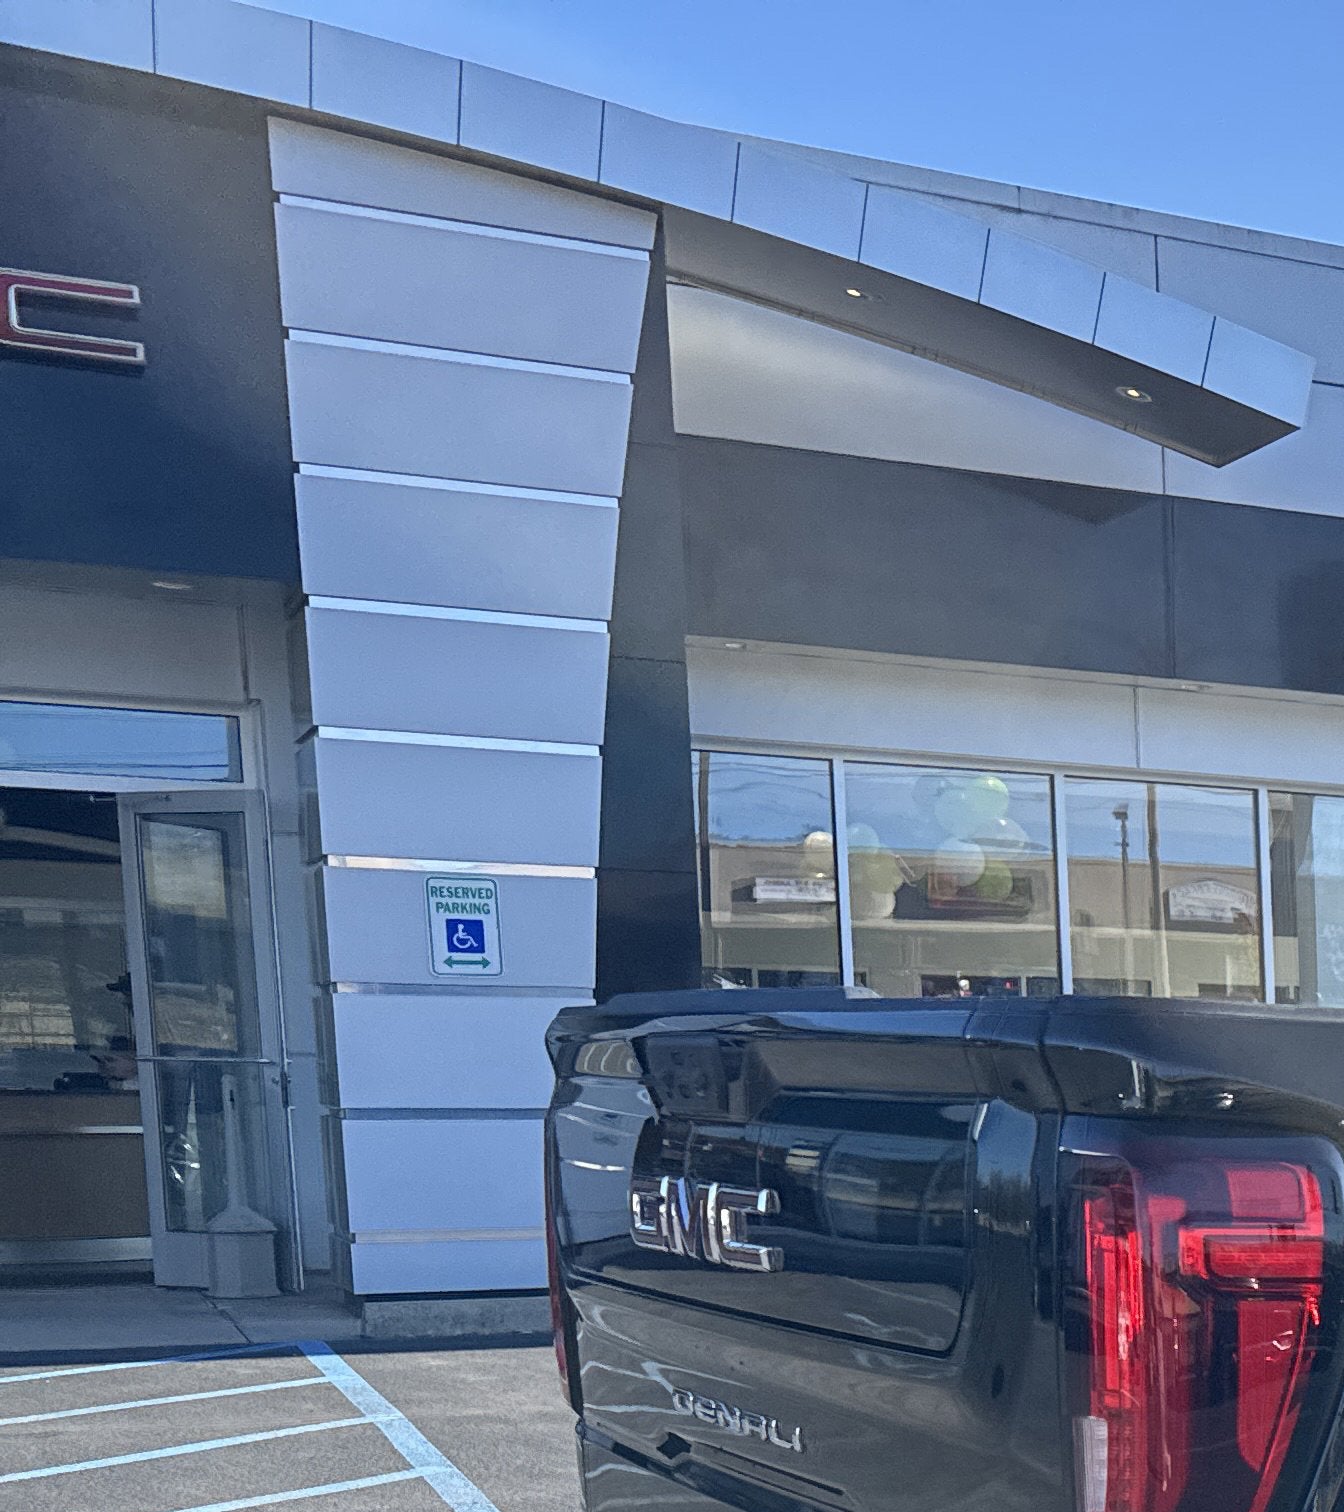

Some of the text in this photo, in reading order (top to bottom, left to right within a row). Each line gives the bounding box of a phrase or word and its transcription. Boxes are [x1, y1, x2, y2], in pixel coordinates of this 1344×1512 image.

[430, 885, 494, 900] RESERVED
[435, 901, 491, 915] PARKING
[627, 1175, 785, 1273] GMC
[672, 1386, 802, 1453] DENALI
